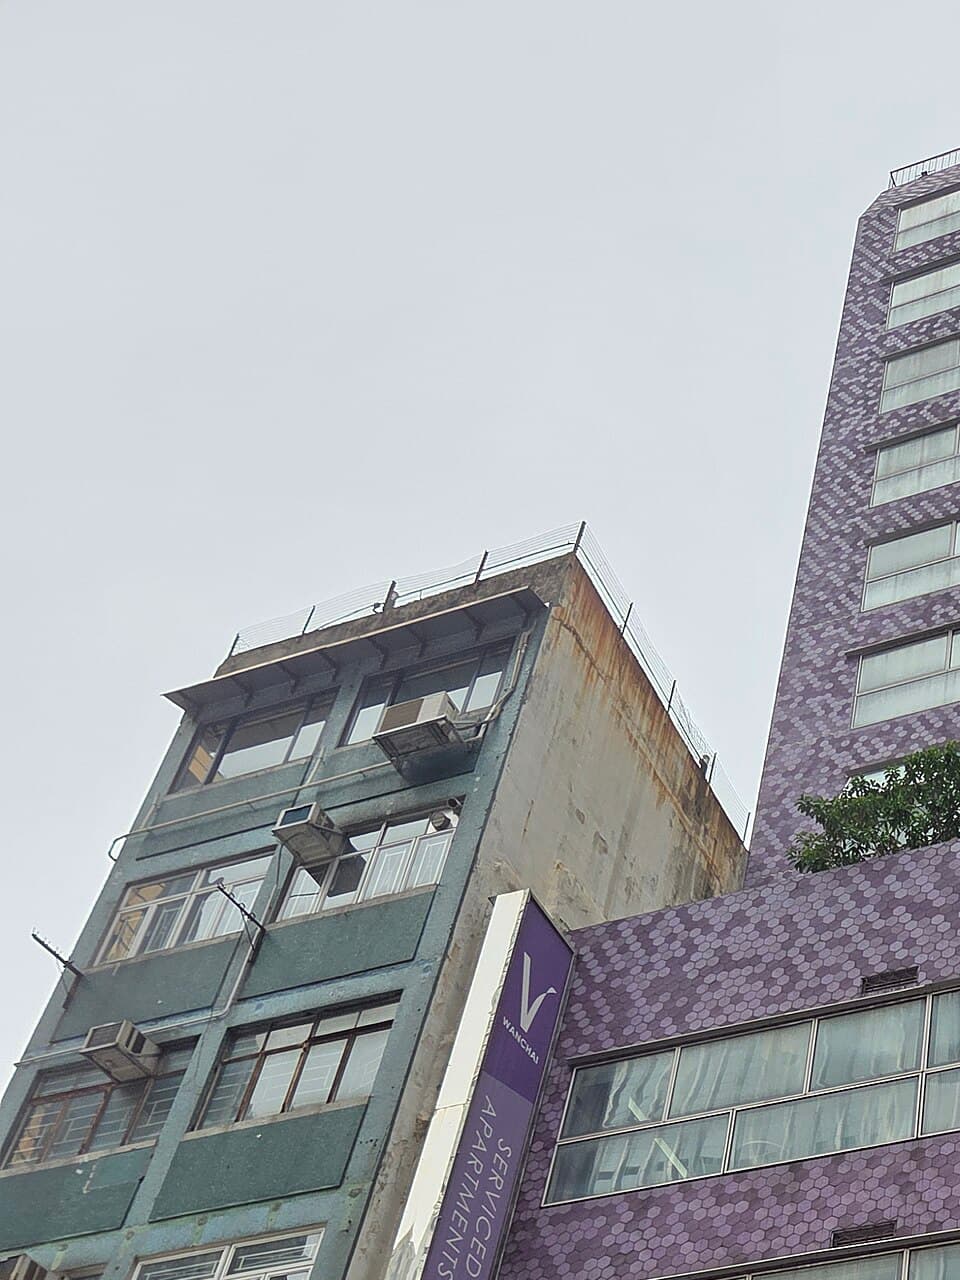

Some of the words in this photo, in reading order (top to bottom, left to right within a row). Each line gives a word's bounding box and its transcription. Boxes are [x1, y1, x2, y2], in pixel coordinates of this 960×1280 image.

[520, 951, 557, 1033] V
[503, 1016, 539, 1064] WANCHAI
[466, 1138, 512, 1278] SERVICED
